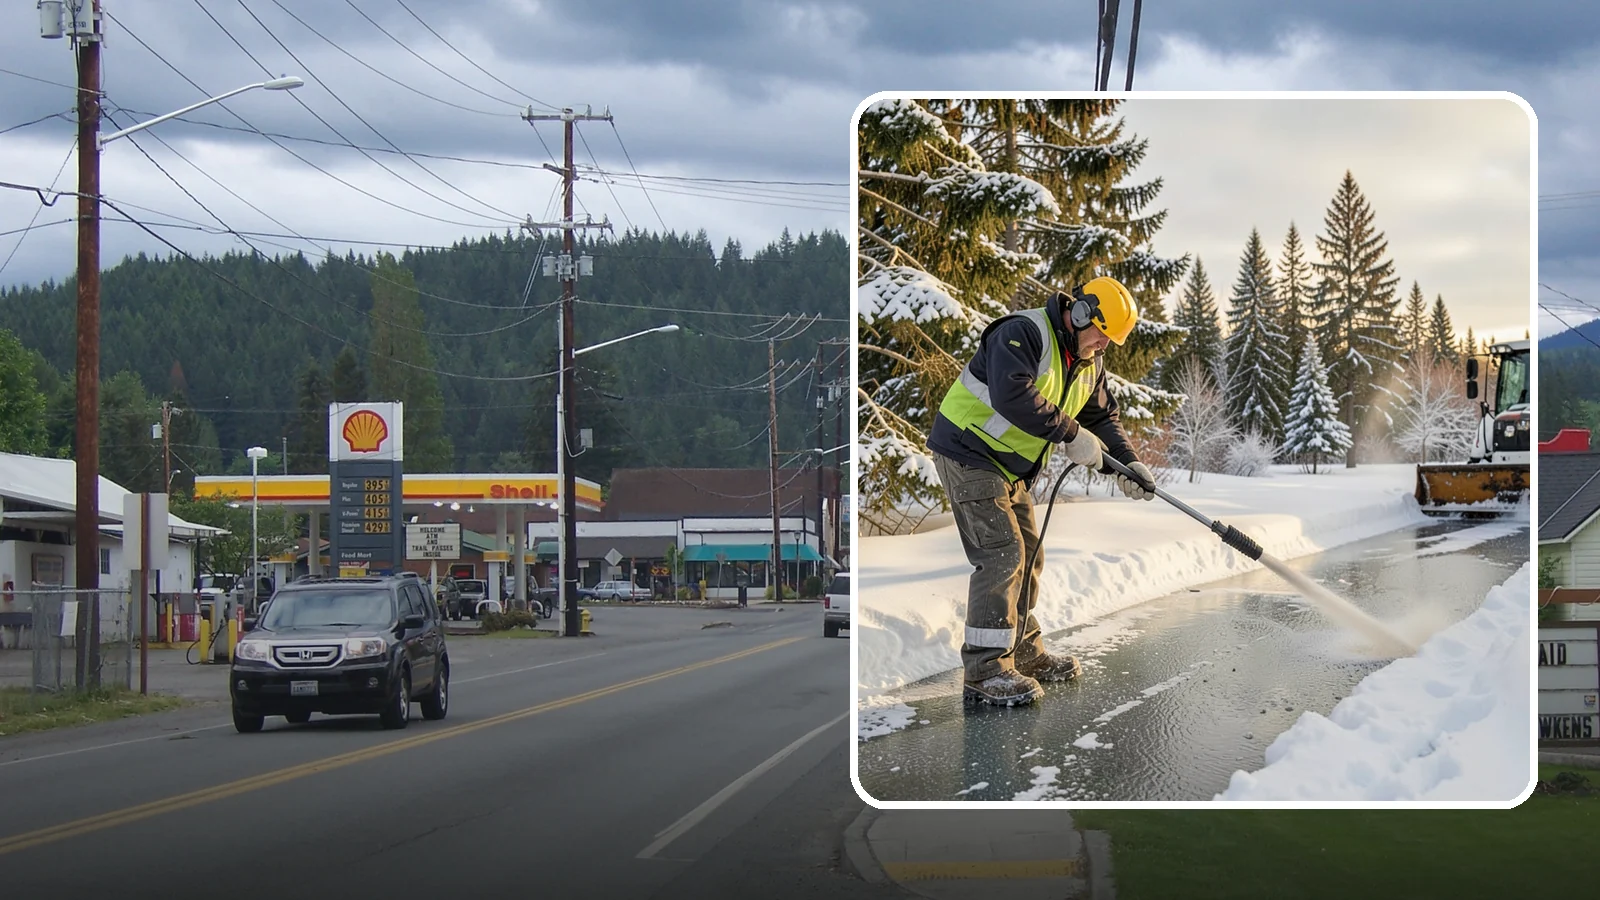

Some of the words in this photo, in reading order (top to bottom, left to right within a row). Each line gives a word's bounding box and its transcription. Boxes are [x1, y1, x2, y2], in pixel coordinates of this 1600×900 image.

[366, 480, 383, 490] 395
[490, 484, 547, 499] Shell
[365, 494, 383, 504] 405
[365, 508, 383, 518] 415
[366, 522, 383, 532] 429
